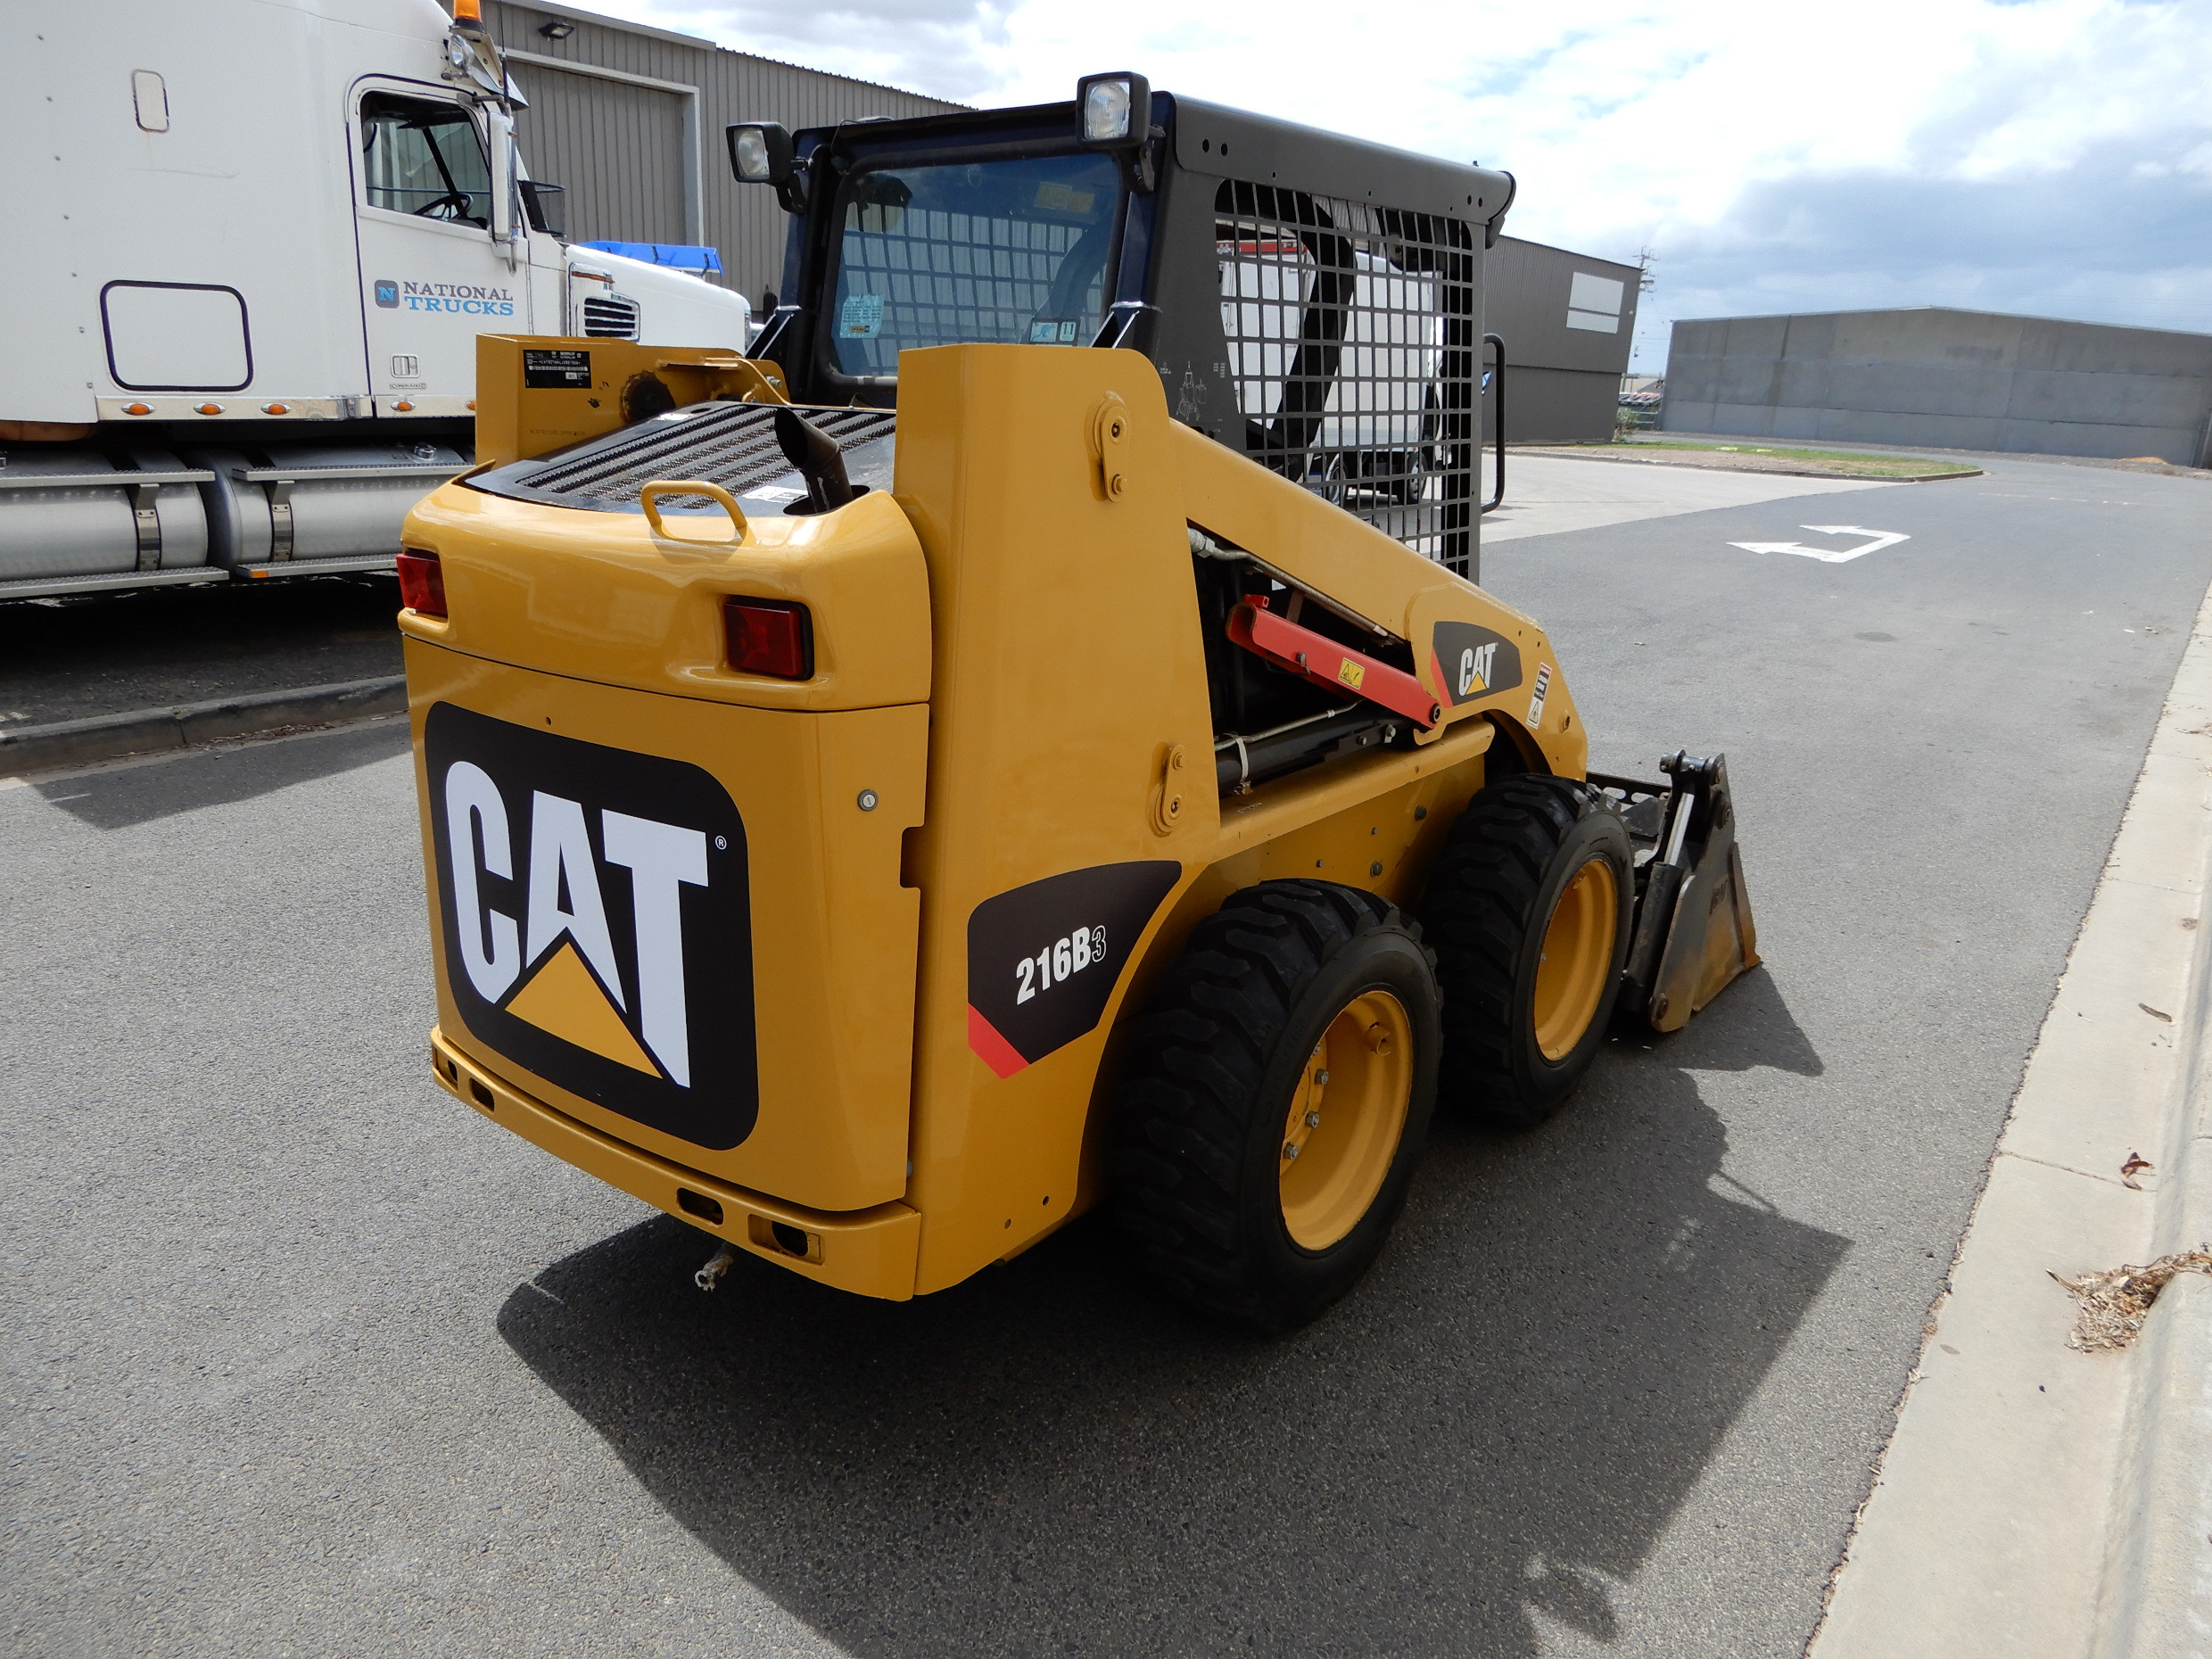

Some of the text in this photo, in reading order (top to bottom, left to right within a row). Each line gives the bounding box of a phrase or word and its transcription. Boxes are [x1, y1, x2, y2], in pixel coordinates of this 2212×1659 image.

[378, 286, 396, 301] N
[403, 281, 514, 301] NATIONAL
[404, 296, 514, 316] TRUCKS
[1063, 323, 1075, 335] 11
[1458, 642, 1497, 697] CAT
[445, 760, 709, 1089] CAT
[1016, 924, 1107, 1006] 216B3
